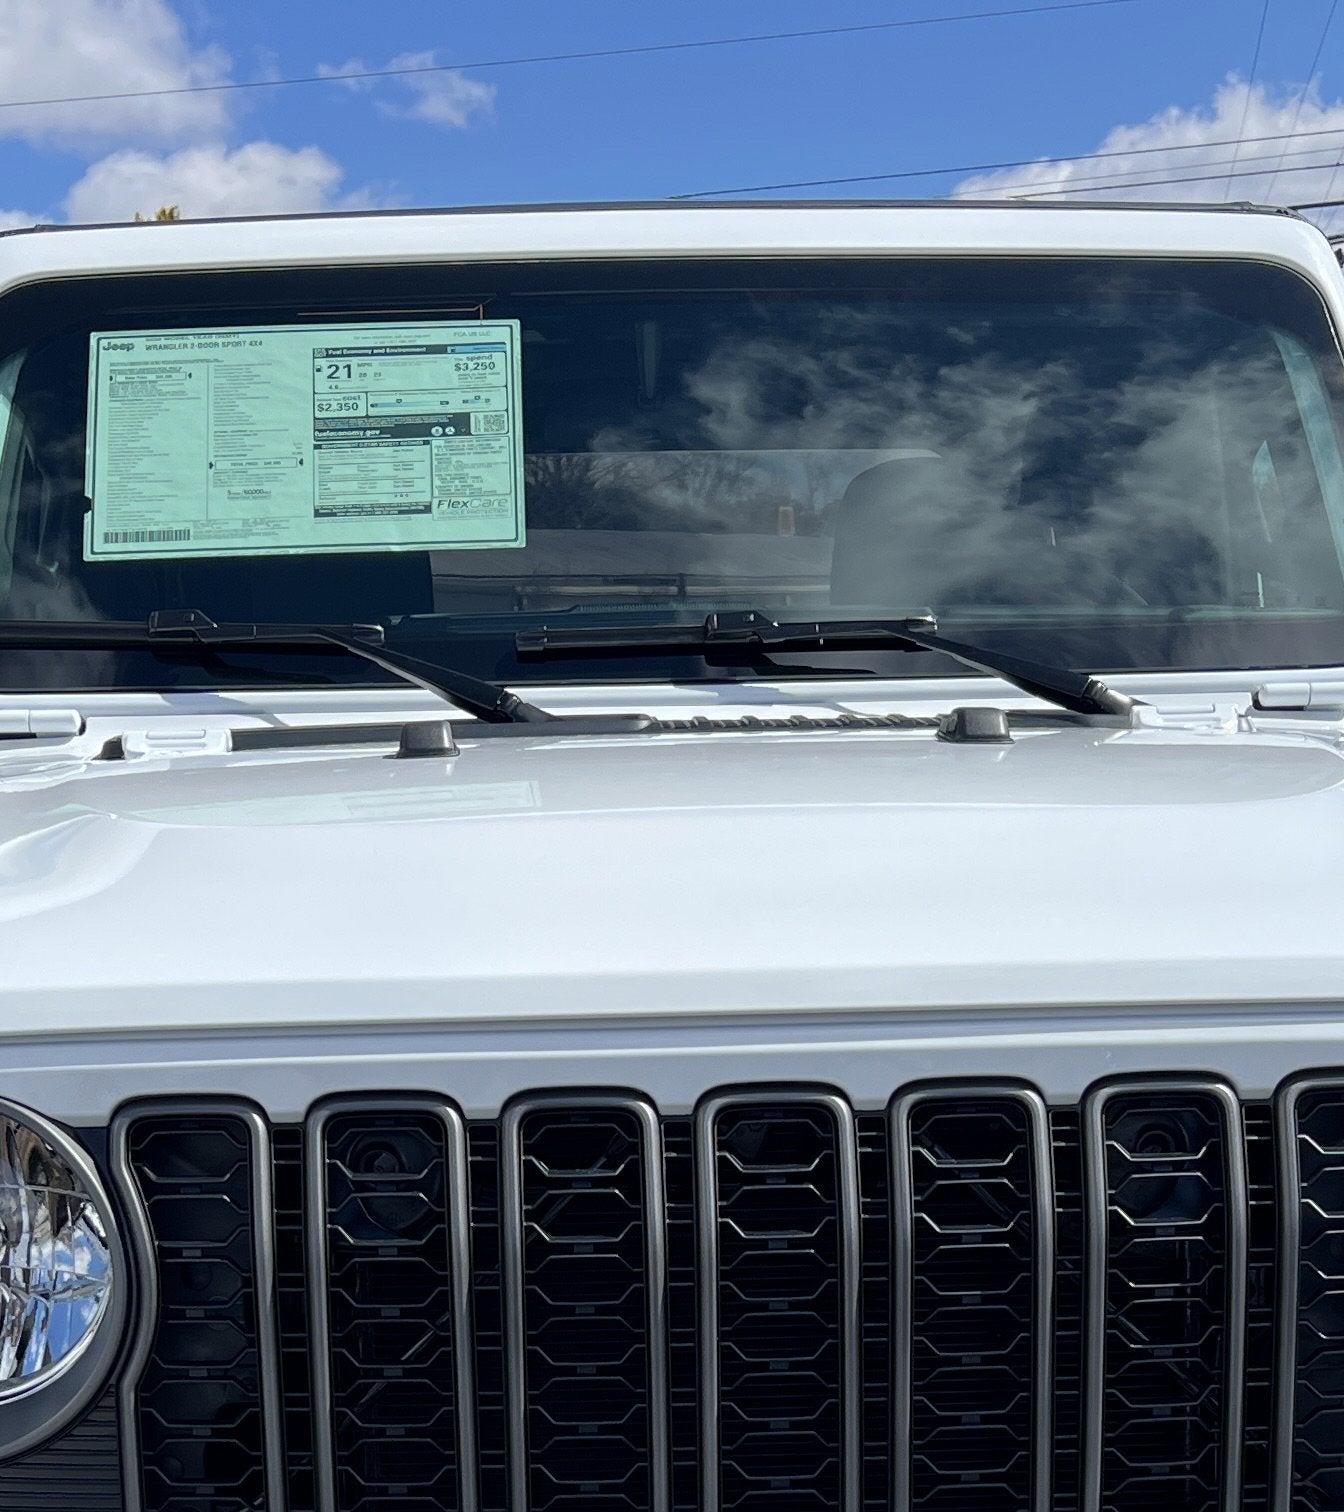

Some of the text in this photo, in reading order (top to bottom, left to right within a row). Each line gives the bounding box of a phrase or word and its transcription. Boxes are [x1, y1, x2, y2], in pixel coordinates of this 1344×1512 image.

[102, 341, 135, 352] Jeep
[145, 339, 263, 351] WRANGLER 2-DOOR SPORT 4X4
[326, 364, 352, 379] 21
[454, 361, 496, 373] $3,250
[316, 402, 358, 413] $2,350
[437, 497, 508, 510] FlexCare
